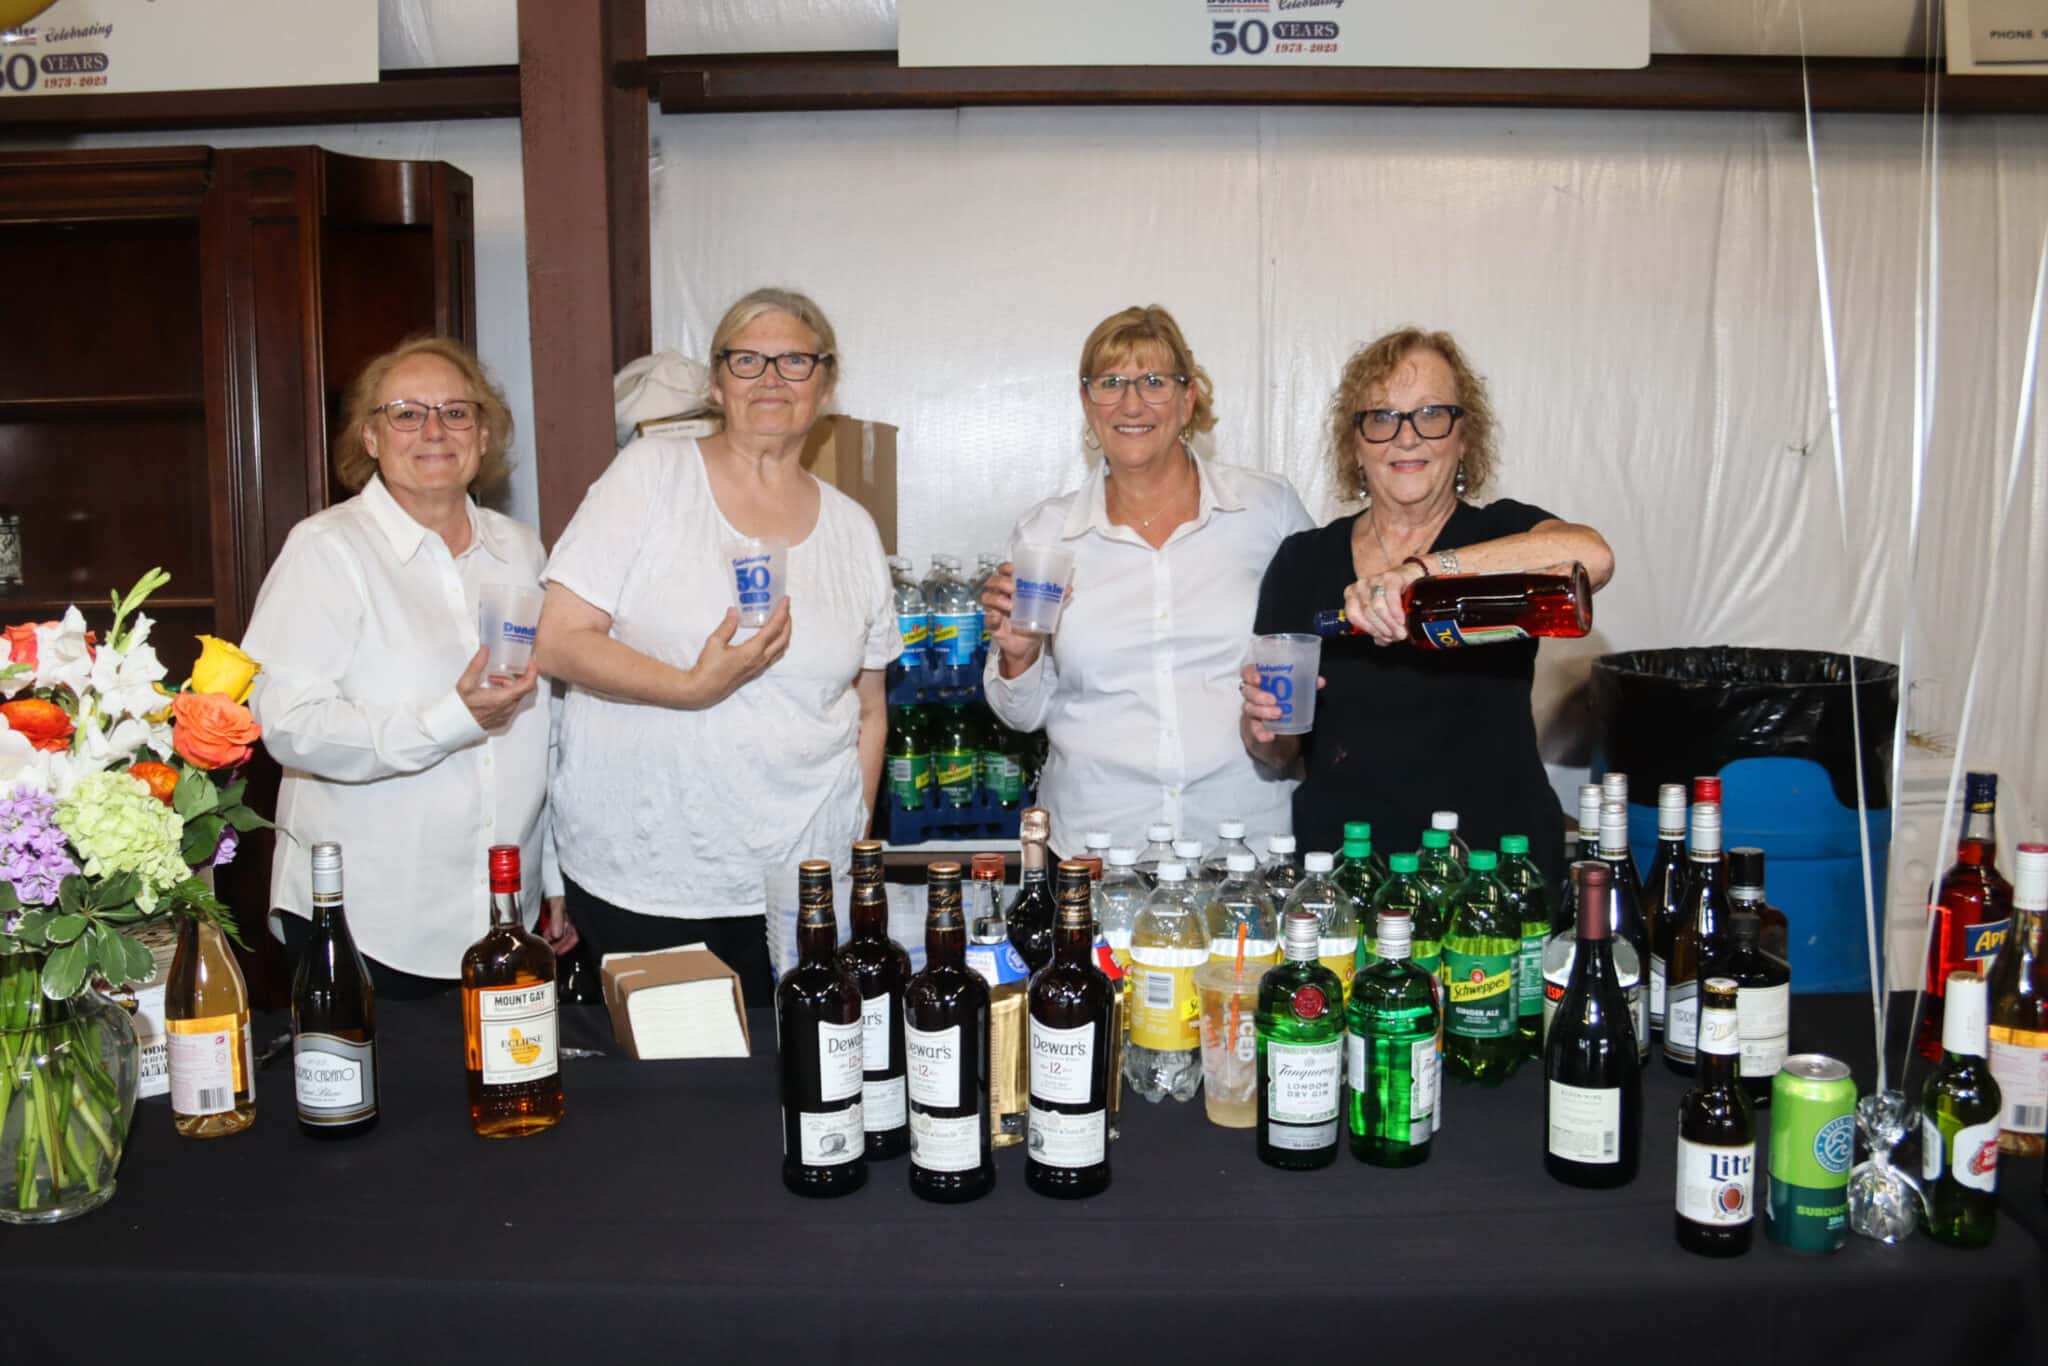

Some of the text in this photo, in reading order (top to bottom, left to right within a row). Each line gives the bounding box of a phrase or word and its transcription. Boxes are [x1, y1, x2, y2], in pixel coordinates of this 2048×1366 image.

[45, 22, 113, 42] Celebrating
[1211, 19, 1335, 55] 50 YEARS
[1989, 29, 2033, 40] PHONE
[0, 53, 104, 91] 0 YEARS
[735, 566, 770, 592] 50
[494, 990, 545, 1006] MOUNT GAY
[1453, 978, 1505, 1001] Schweppes
[500, 1032, 543, 1048] ECLIPSE
[1033, 1033, 1087, 1056] Dewar's
[918, 1063, 929, 1078] 12
[1050, 1061, 1062, 1075] 12
[1286, 1090, 1329, 1098] DRY GIN
[1287, 1082, 1329, 1090] LONDON
[1709, 1152, 1751, 1183] Lite
